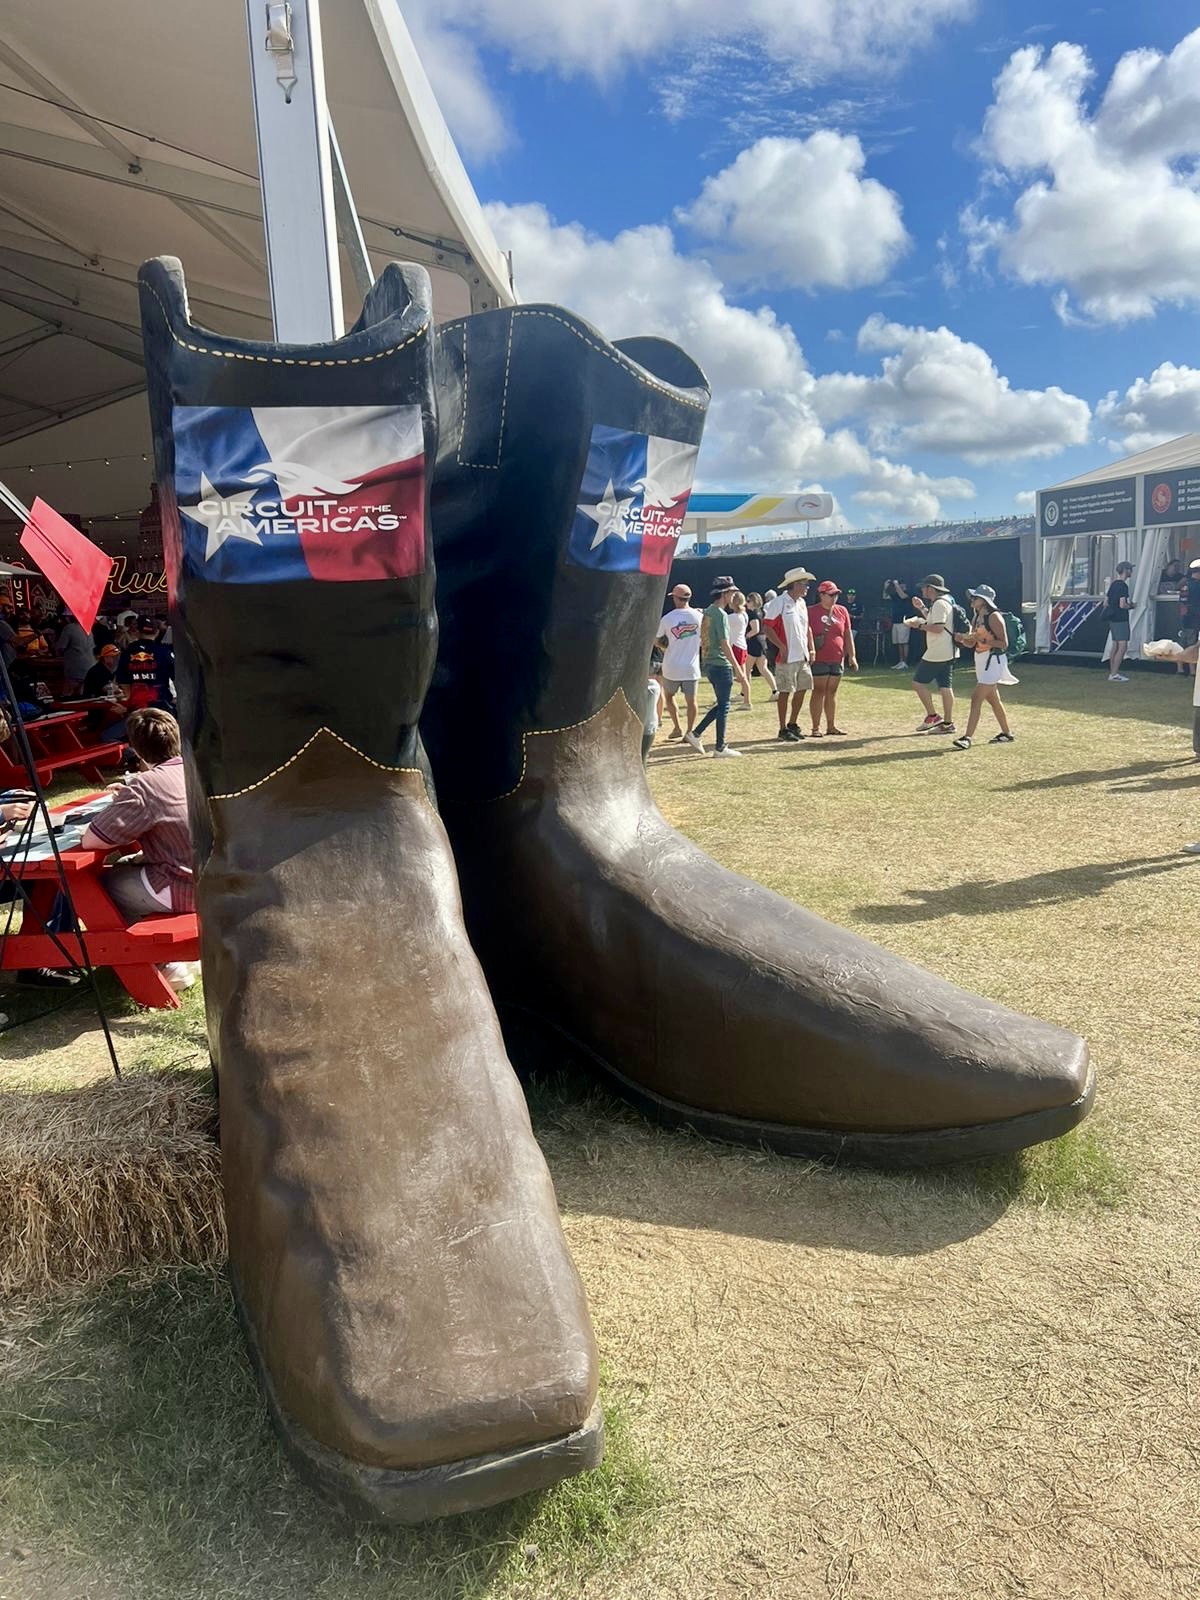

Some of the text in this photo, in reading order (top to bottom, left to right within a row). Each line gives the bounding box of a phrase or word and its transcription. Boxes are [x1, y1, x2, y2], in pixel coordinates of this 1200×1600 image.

[197, 500, 392, 518] CIRCUIT OF THE
[596, 502, 665, 523] CIRCUIT
[603, 519, 682, 538] AMERICAS
